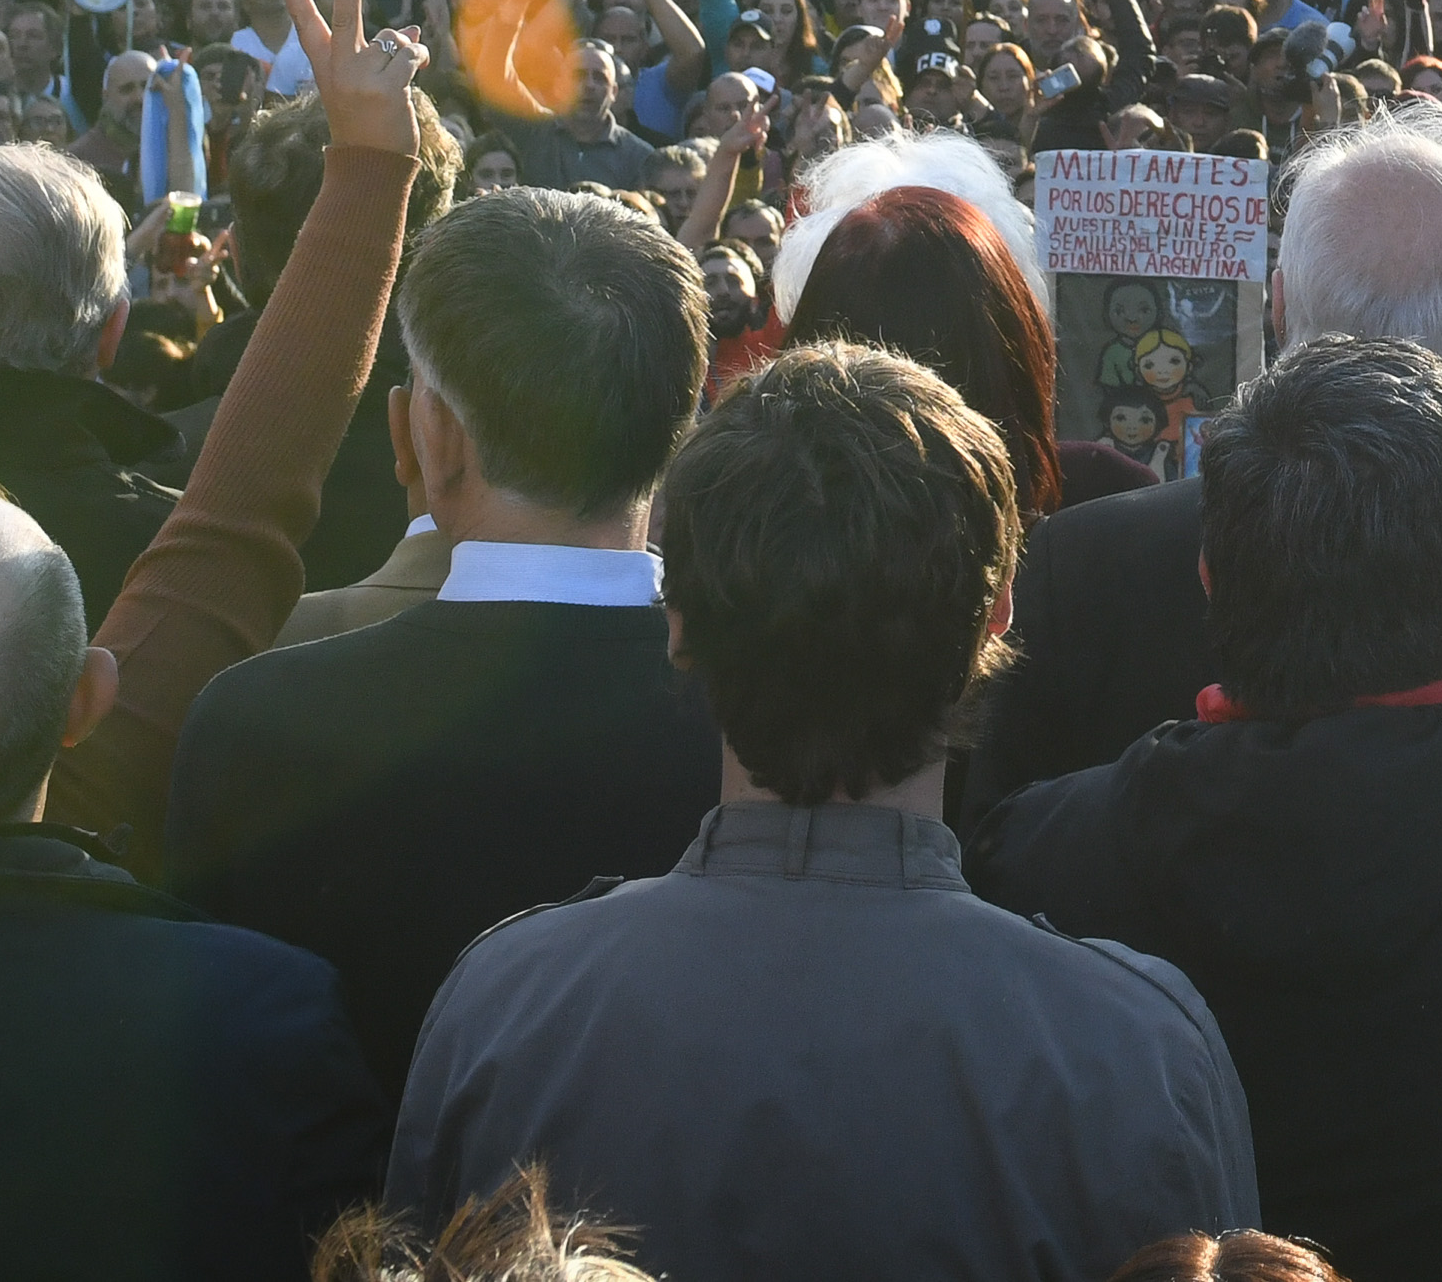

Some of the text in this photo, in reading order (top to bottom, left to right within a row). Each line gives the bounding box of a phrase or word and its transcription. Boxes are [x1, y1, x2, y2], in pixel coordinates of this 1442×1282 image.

[1050, 150, 1250, 187] MILITANTES
[1048, 187, 1266, 226] POR LOS DERECHOS DE
[1053, 215, 1137, 237] NUESTRA
[1049, 233, 1237, 260] SEMILLAS DEL FUTURO
[1144, 254, 1250, 280] ARGENTINA
